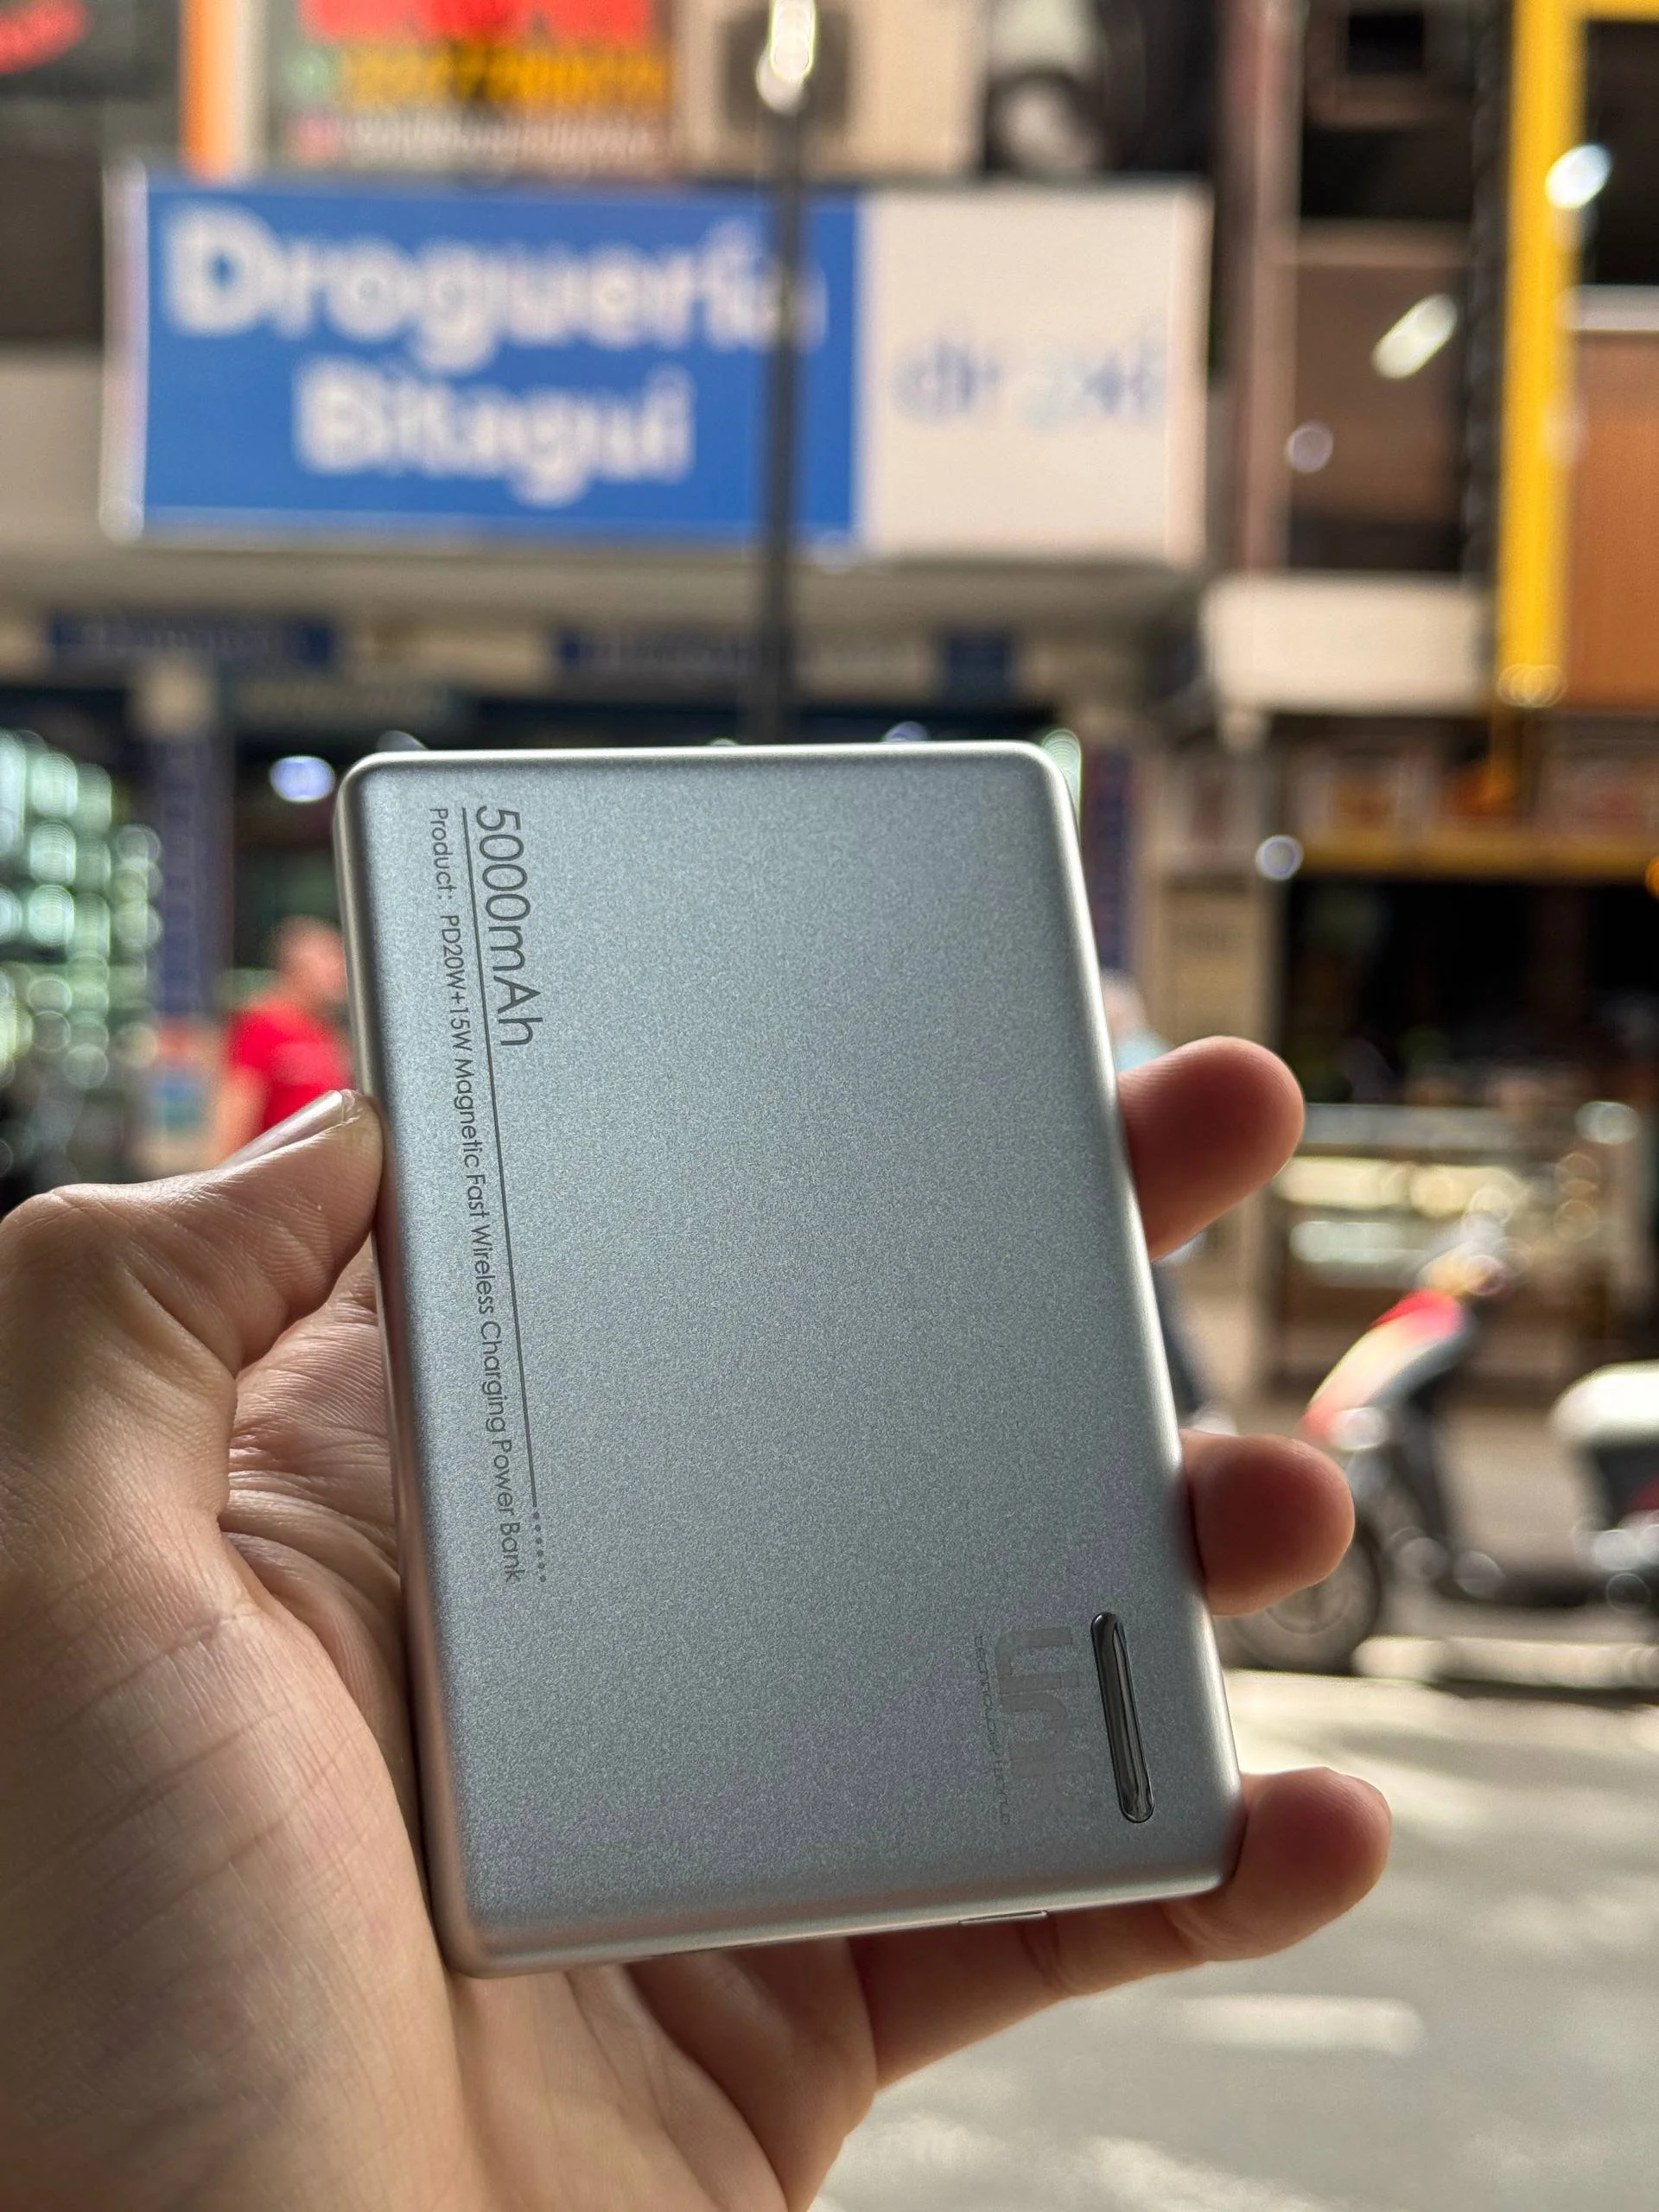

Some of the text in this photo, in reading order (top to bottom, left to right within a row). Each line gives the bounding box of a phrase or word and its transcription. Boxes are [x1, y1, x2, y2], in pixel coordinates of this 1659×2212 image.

[475, 805, 543, 1046] 5000mAh
[429, 807, 525, 1583] Product: PD20W+15W Magnetic Fast Wireless Charging Power Bank
